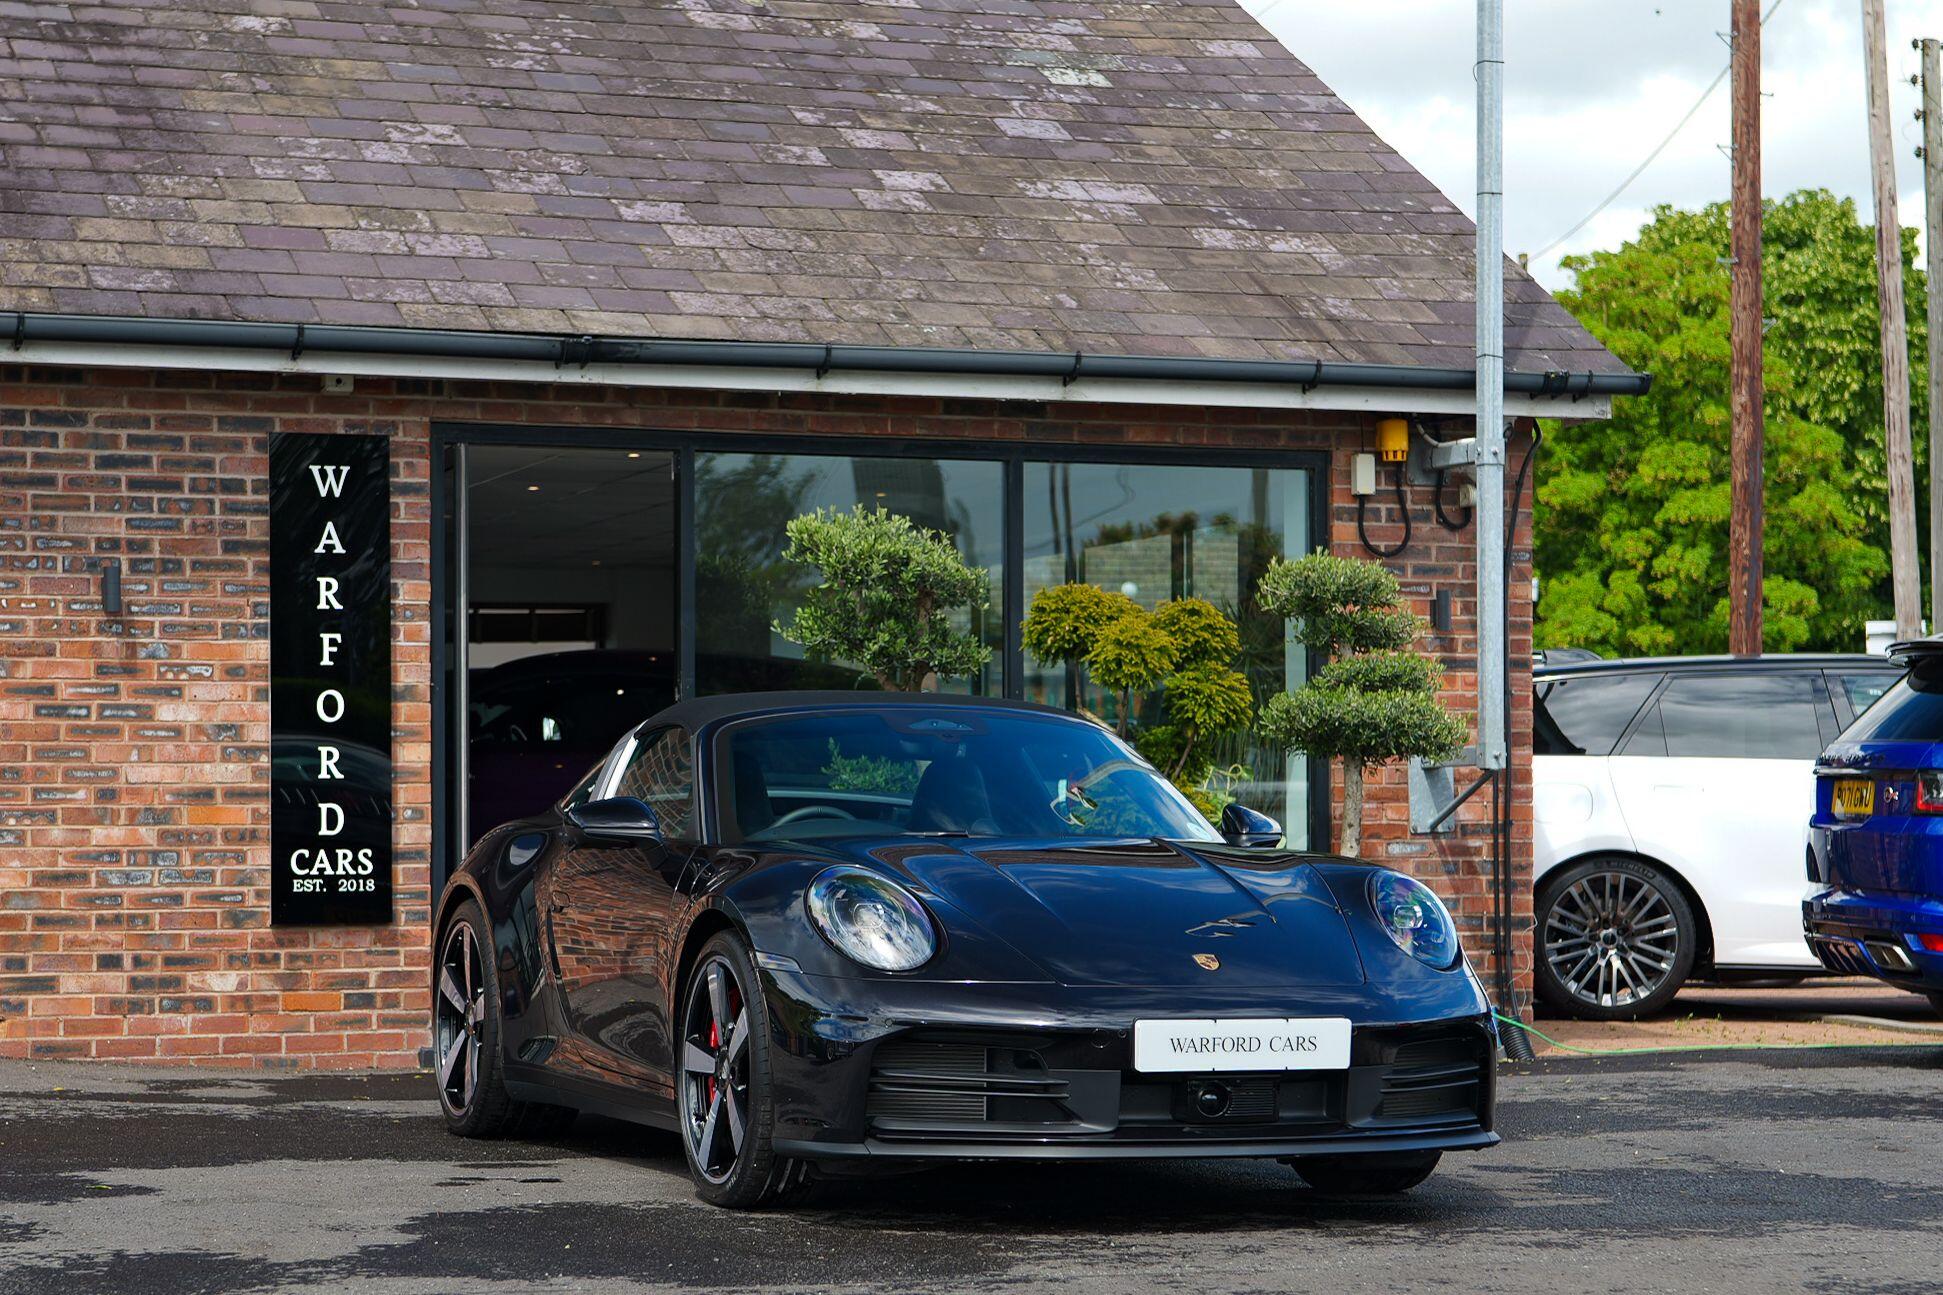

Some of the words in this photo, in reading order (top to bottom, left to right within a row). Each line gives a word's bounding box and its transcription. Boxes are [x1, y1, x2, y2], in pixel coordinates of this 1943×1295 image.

[308, 465, 351, 836] WARFORD
[290, 848, 374, 876] CARS
[292, 878, 327, 893] EST.
[338, 878, 376, 893] 2018
[1170, 1036, 1261, 1054] WARFORD
[1269, 1035, 1318, 1053] CARS
